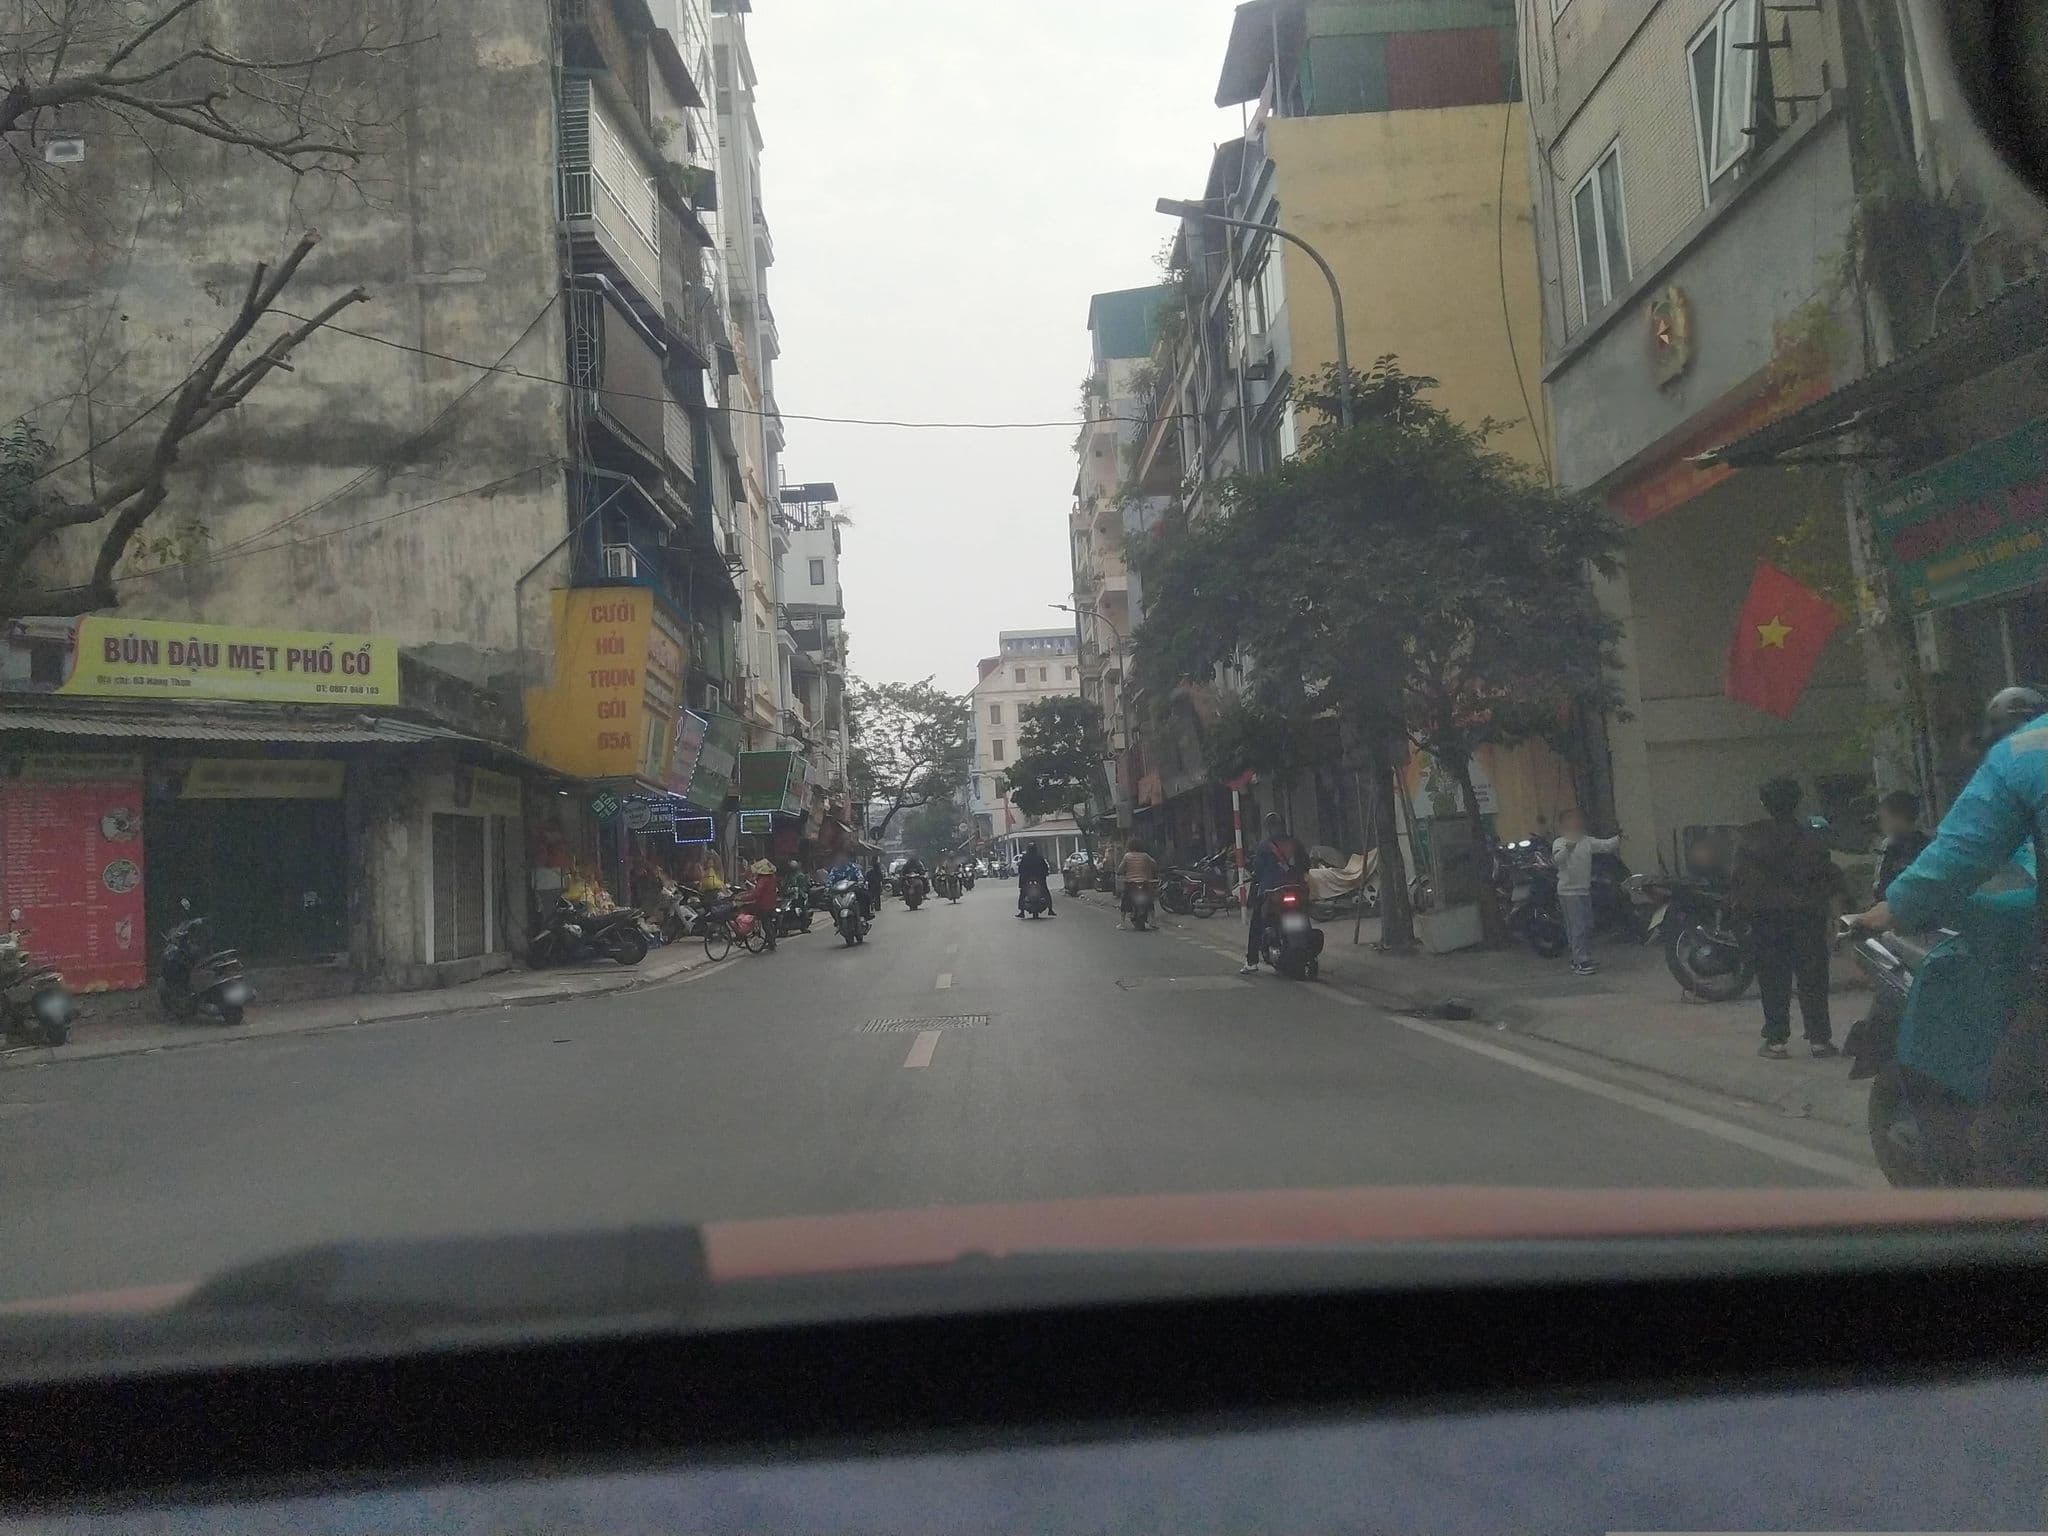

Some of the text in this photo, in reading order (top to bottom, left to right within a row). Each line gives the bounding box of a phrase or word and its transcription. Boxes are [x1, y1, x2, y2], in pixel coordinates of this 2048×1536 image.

[104, 633, 370, 675] BÚN ĐẬU MẸT PHỐ CỔ
[597, 630, 624, 655] HỎI
[588, 670, 635, 691] TRỌN
[598, 697, 625, 719] GÓI
